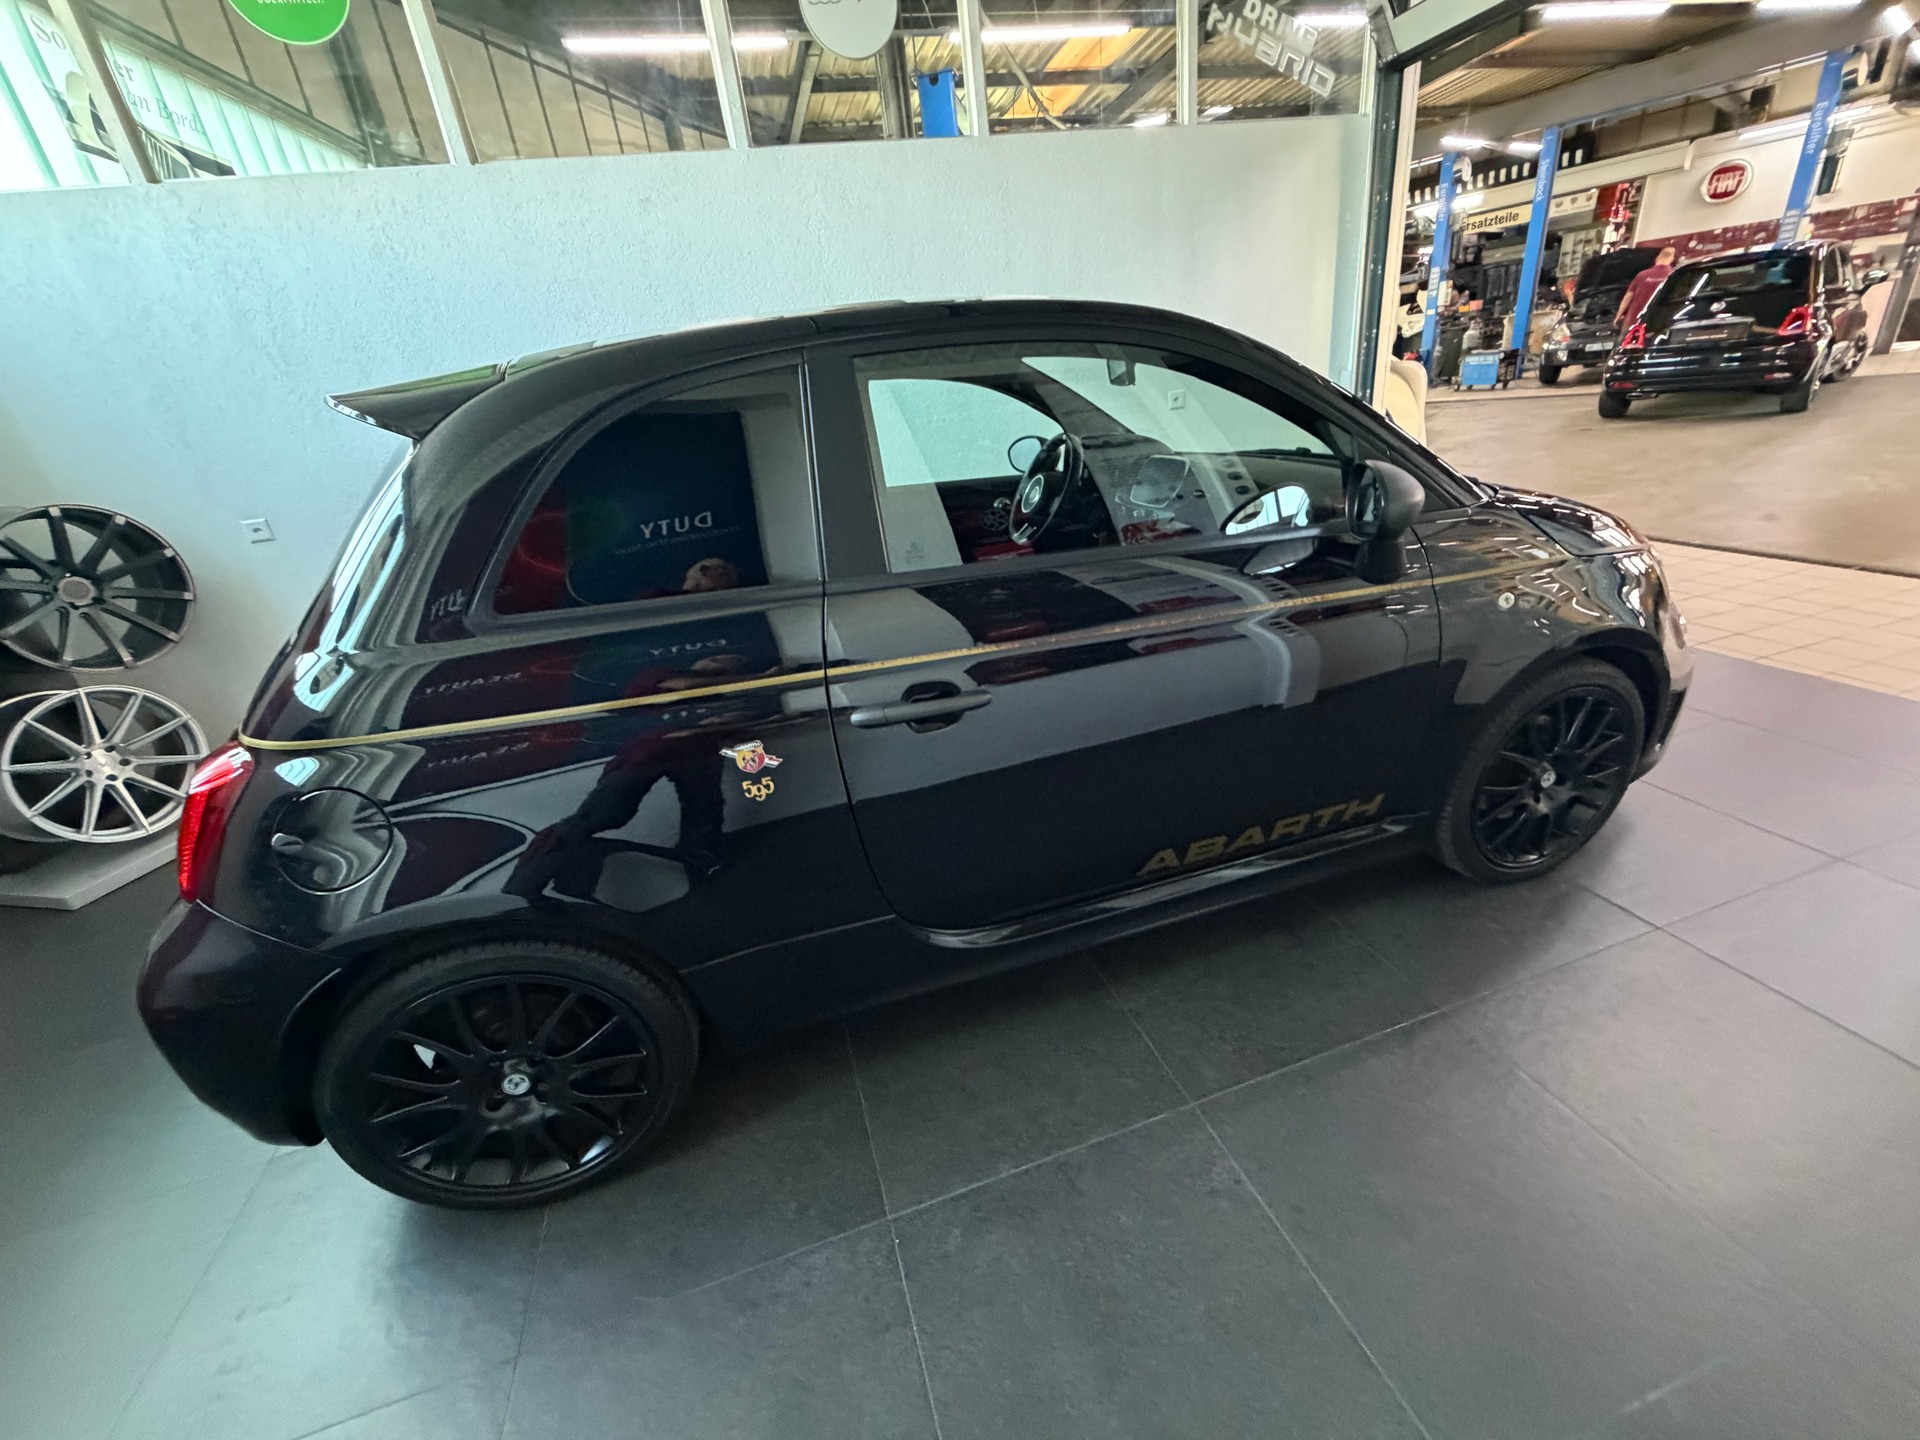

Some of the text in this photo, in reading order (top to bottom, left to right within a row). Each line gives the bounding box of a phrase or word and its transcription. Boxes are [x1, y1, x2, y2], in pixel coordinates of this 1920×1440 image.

[1708, 170, 1744, 195] FIAT
[741, 776, 775, 802] 595
[1136, 793, 1386, 877] ABARTH
